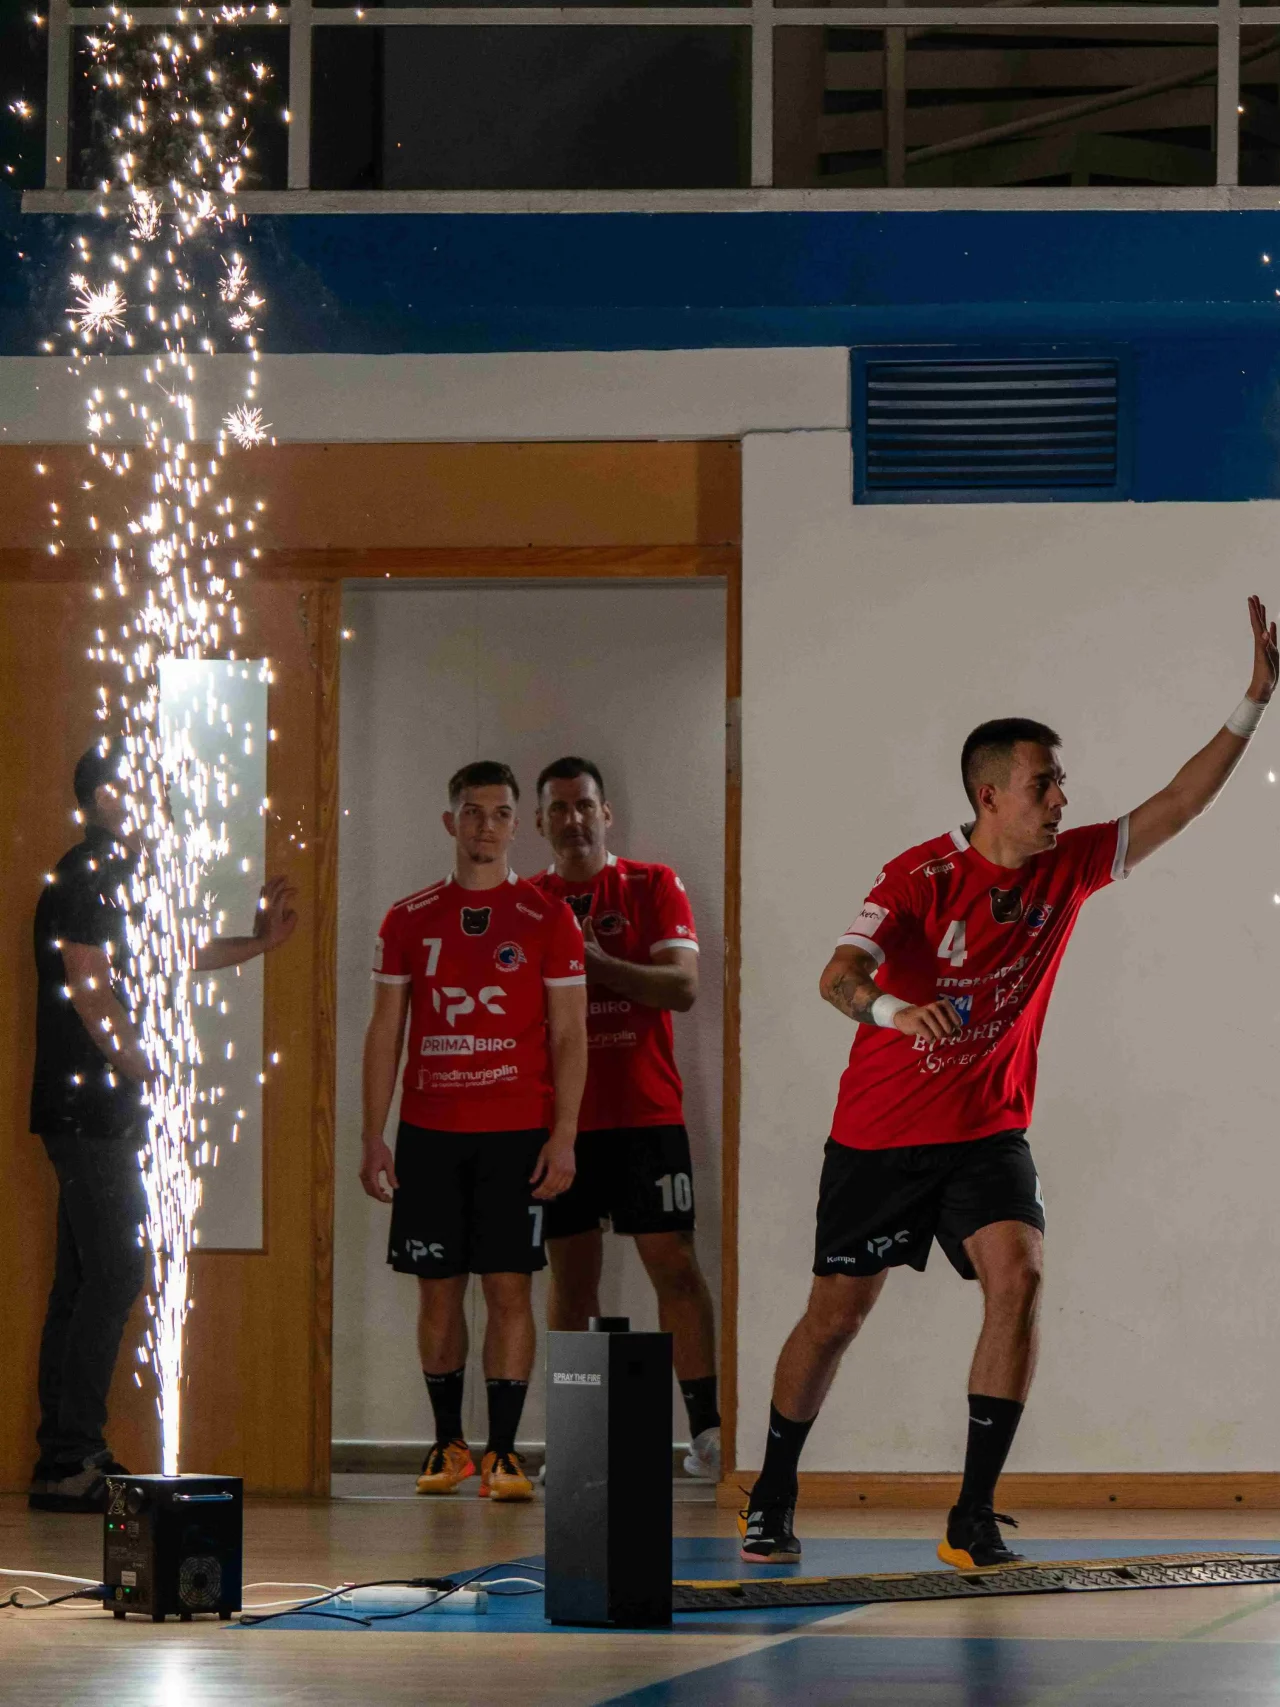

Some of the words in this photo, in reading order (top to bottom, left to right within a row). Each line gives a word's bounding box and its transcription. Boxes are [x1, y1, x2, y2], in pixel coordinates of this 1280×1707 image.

[923, 862, 955, 877] Kempa
[422, 938, 442, 976] 7
[937, 920, 968, 967] 4
[655, 1172, 692, 1211] 10
[528, 1205, 544, 1247] 7
[826, 1256, 856, 1264] Kempa
[553, 1372, 573, 1381] SPRAY
[574, 1373, 586, 1382] THE
[587, 1373, 601, 1382] FIRE
